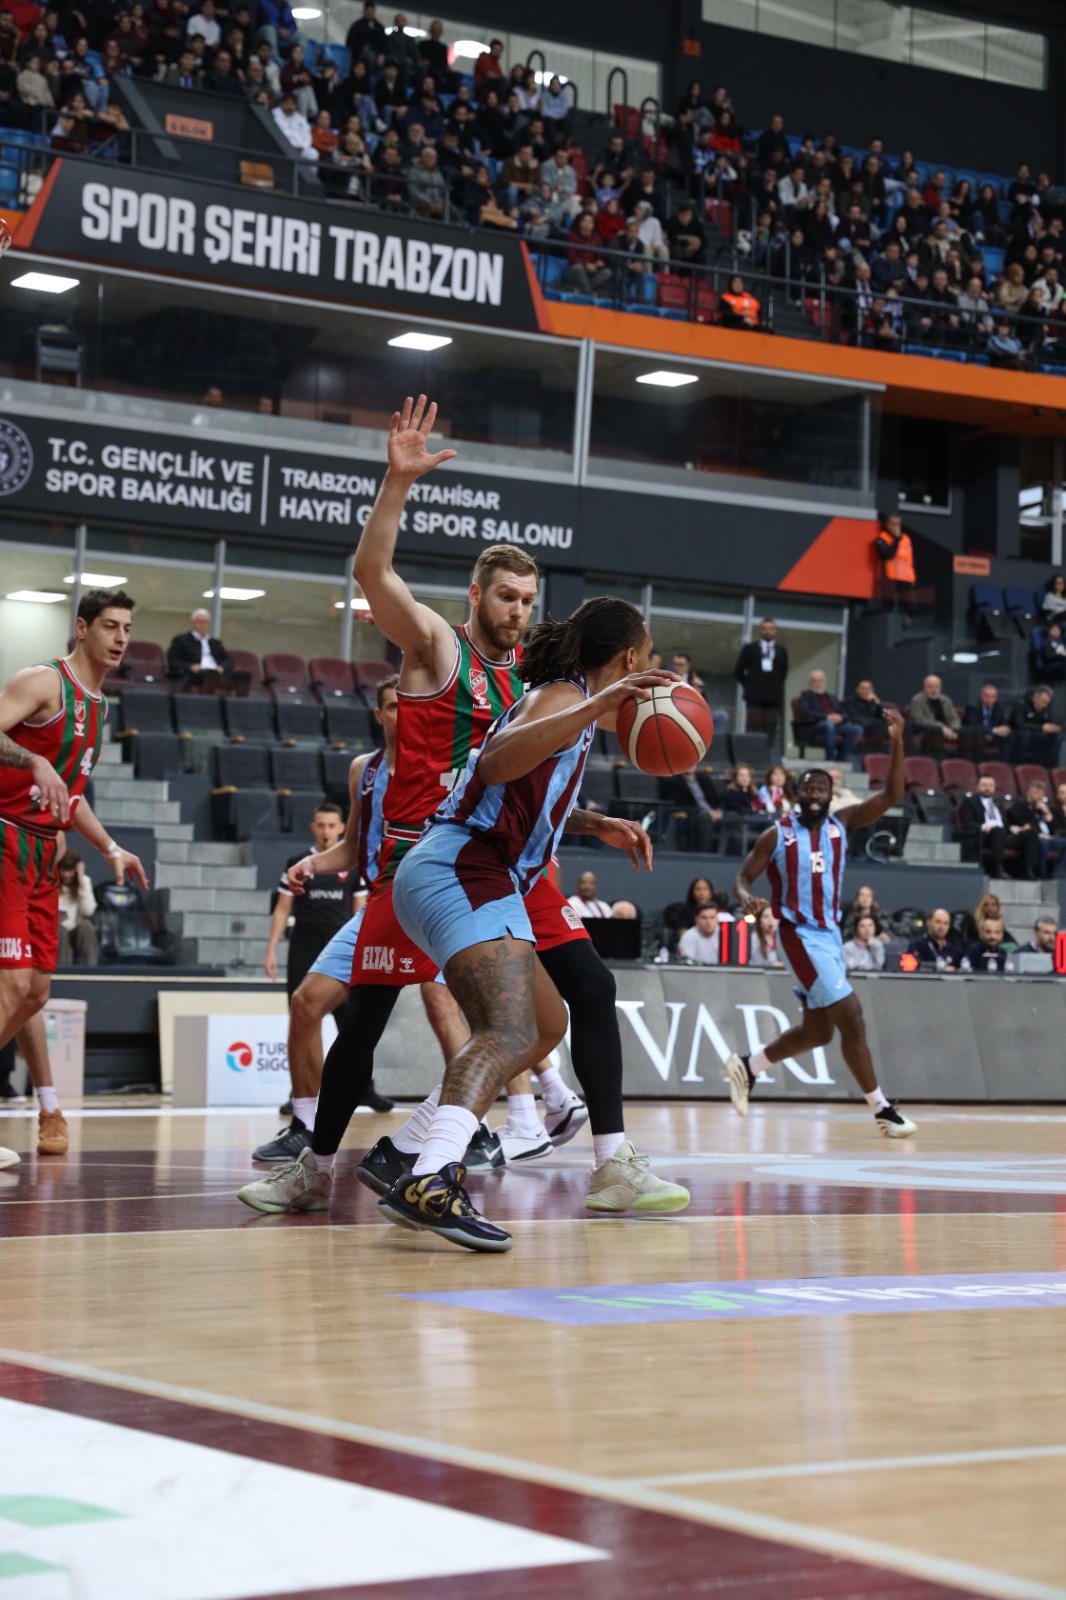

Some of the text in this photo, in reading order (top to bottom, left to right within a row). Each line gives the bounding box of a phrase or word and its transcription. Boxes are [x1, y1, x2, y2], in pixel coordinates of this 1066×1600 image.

[81, 182, 196, 255] SPOR
[329, 225, 503, 306] TRABZON
[48, 437, 254, 485] T.C. GENÇLİK VE
[45, 469, 252, 514] SPOR BAKANLIĞI
[281, 467, 500, 511] TRABZON RTAHİSAR
[279, 496, 352, 525] HAYRİ
[412, 510, 477, 539] SPOR
[481, 517, 573, 549] SALONU
[809, 851, 826, 874] 15
